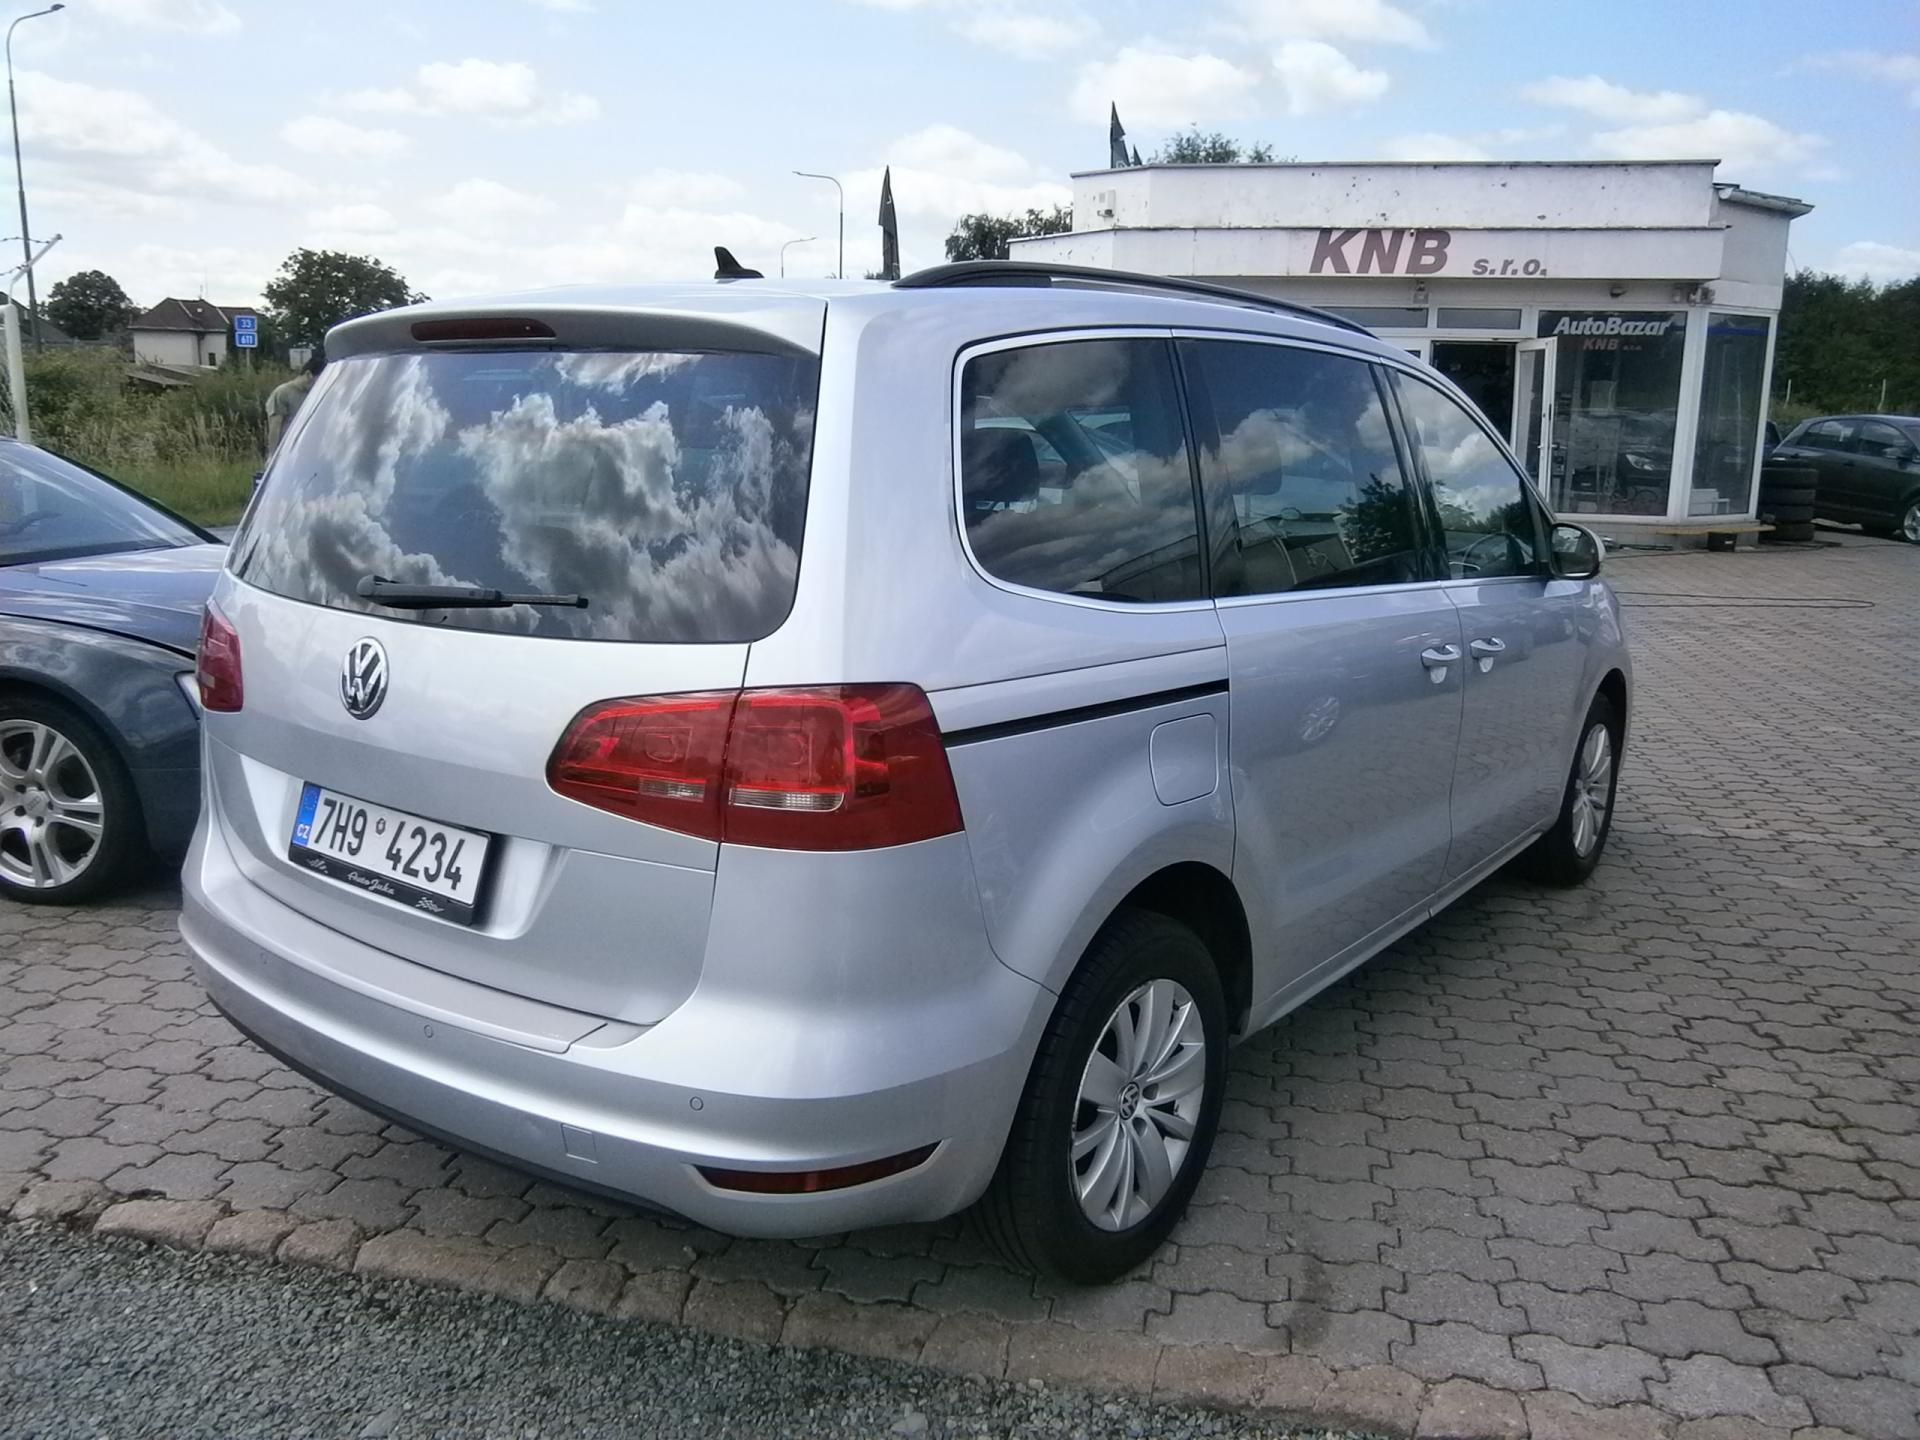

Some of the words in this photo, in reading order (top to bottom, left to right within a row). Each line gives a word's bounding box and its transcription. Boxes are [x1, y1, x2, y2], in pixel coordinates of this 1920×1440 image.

[1308, 228, 1451, 275] KNB
[1472, 257, 1548, 276] s.r.o.
[1552, 316, 1673, 336] AutoBazar
[1583, 337, 1619, 351] KNB
[297, 823, 312, 840] CZ
[313, 797, 368, 856] 7H9
[385, 820, 466, 890] 4234
